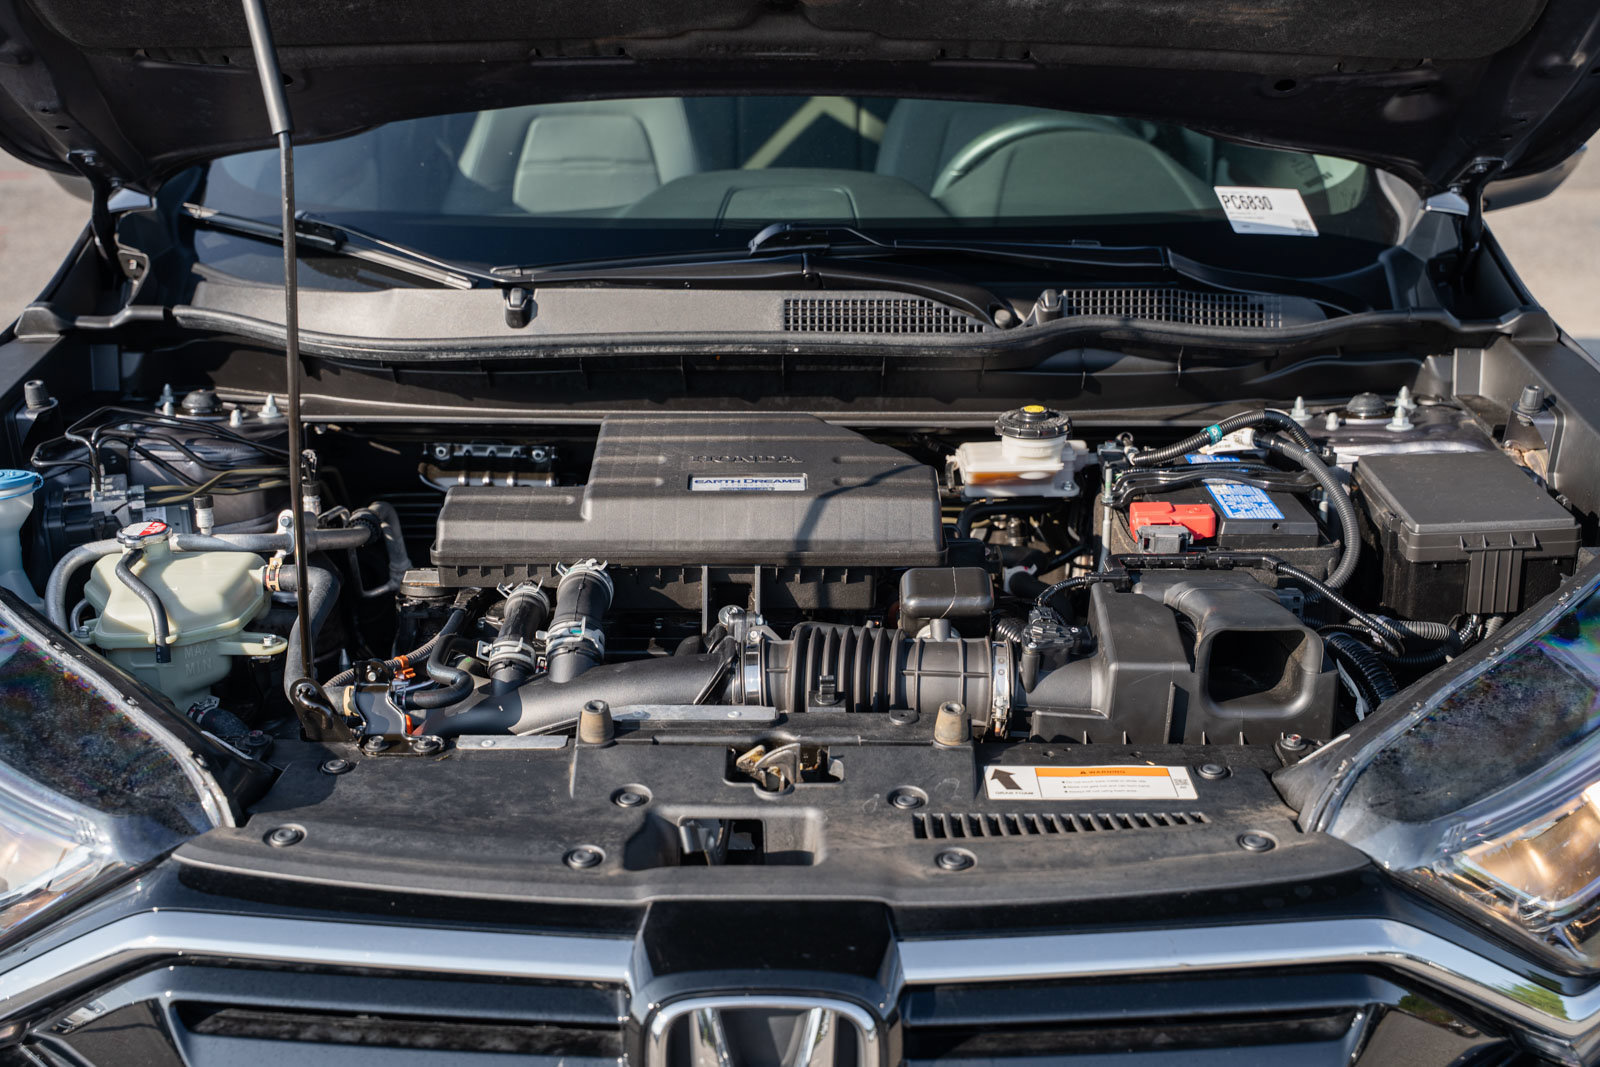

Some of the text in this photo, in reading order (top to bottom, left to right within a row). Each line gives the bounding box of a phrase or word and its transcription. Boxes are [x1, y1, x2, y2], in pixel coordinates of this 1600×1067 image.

[1221, 194, 1273, 210] PC6830
[688, 455, 804, 464] HONDA
[184, 643, 210, 659] MAX
[185, 658, 212, 677] MIN
